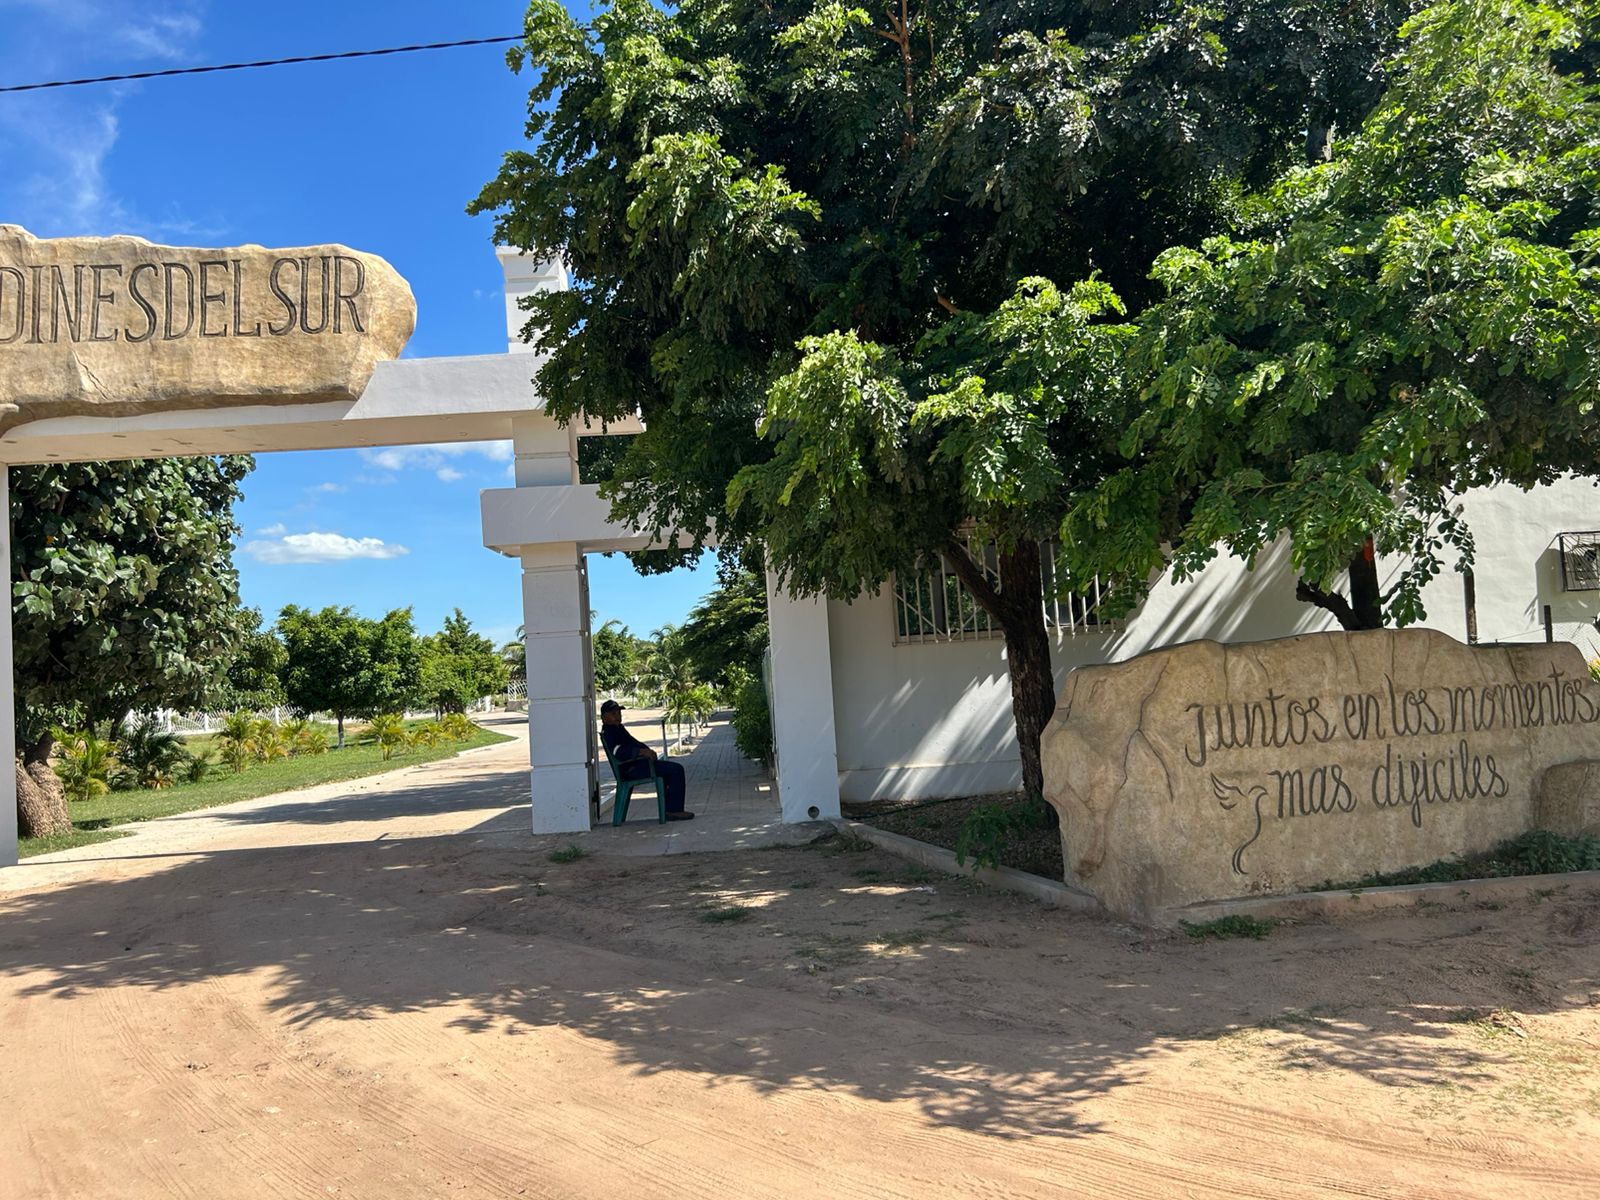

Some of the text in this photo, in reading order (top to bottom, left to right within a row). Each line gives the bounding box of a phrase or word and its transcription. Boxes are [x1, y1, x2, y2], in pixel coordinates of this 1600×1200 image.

[161, 259, 261, 341] DEL
[267, 255, 366, 336] SUR
[1343, 692, 1386, 741] en
[1383, 672, 1446, 736] los
[1443, 661, 1600, 732] momentos
[1268, 763, 1358, 818] mas
